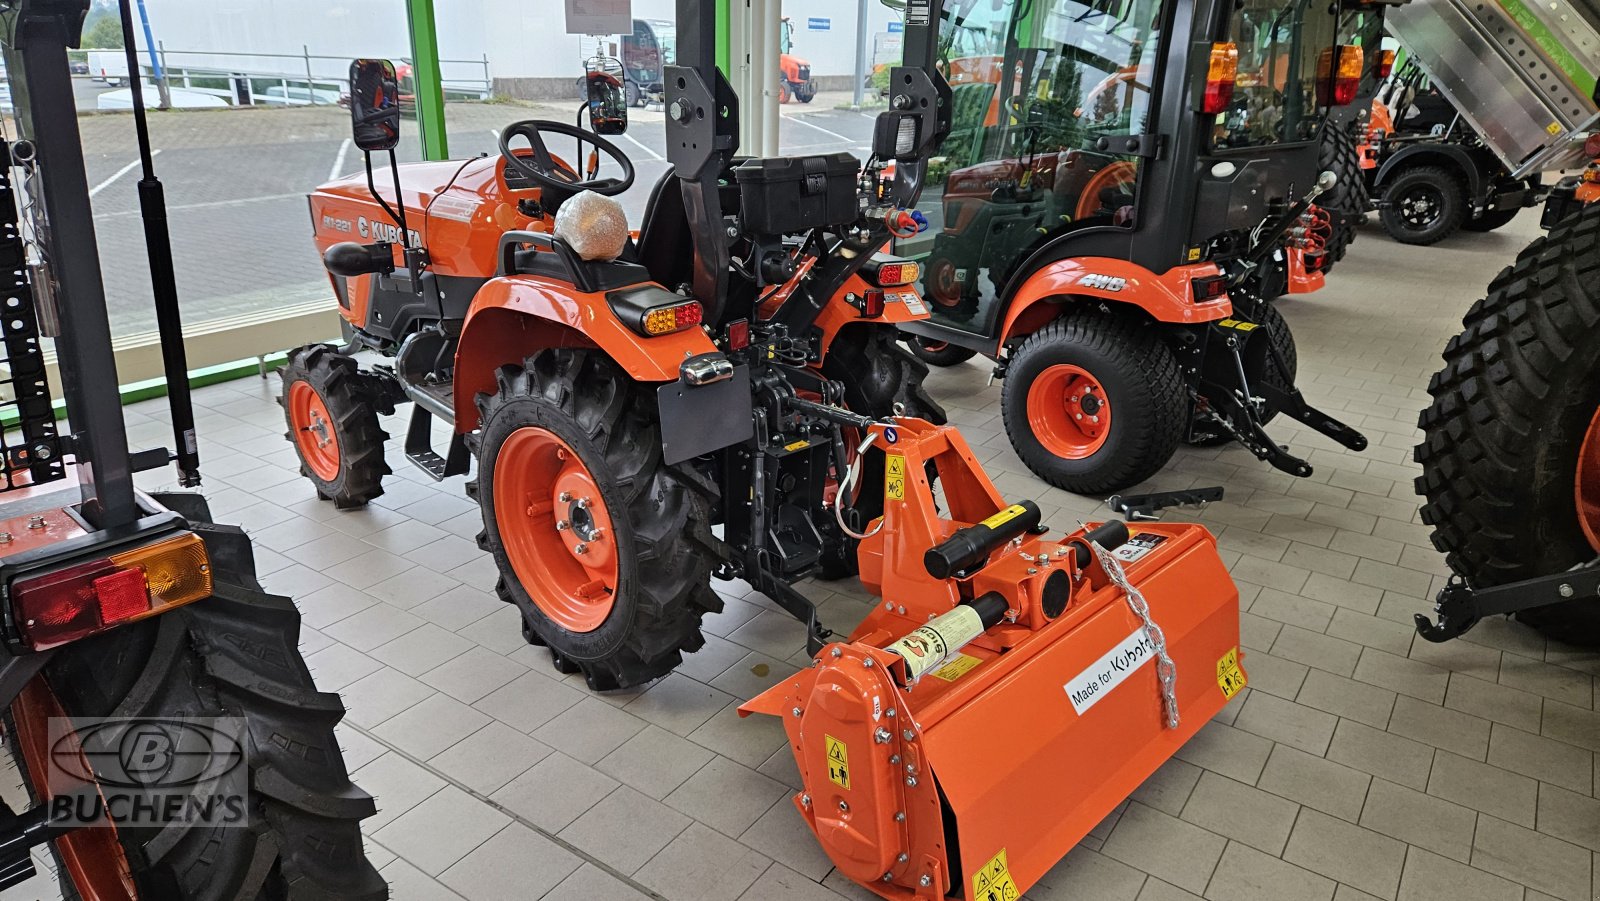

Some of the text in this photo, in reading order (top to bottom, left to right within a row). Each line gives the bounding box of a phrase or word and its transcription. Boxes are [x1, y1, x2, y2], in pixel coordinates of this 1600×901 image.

[371, 220, 423, 248] KUBOTA
[1082, 273, 1127, 292] 4WD
[1071, 682, 1099, 706] Made
[1098, 670, 1113, 686] for
